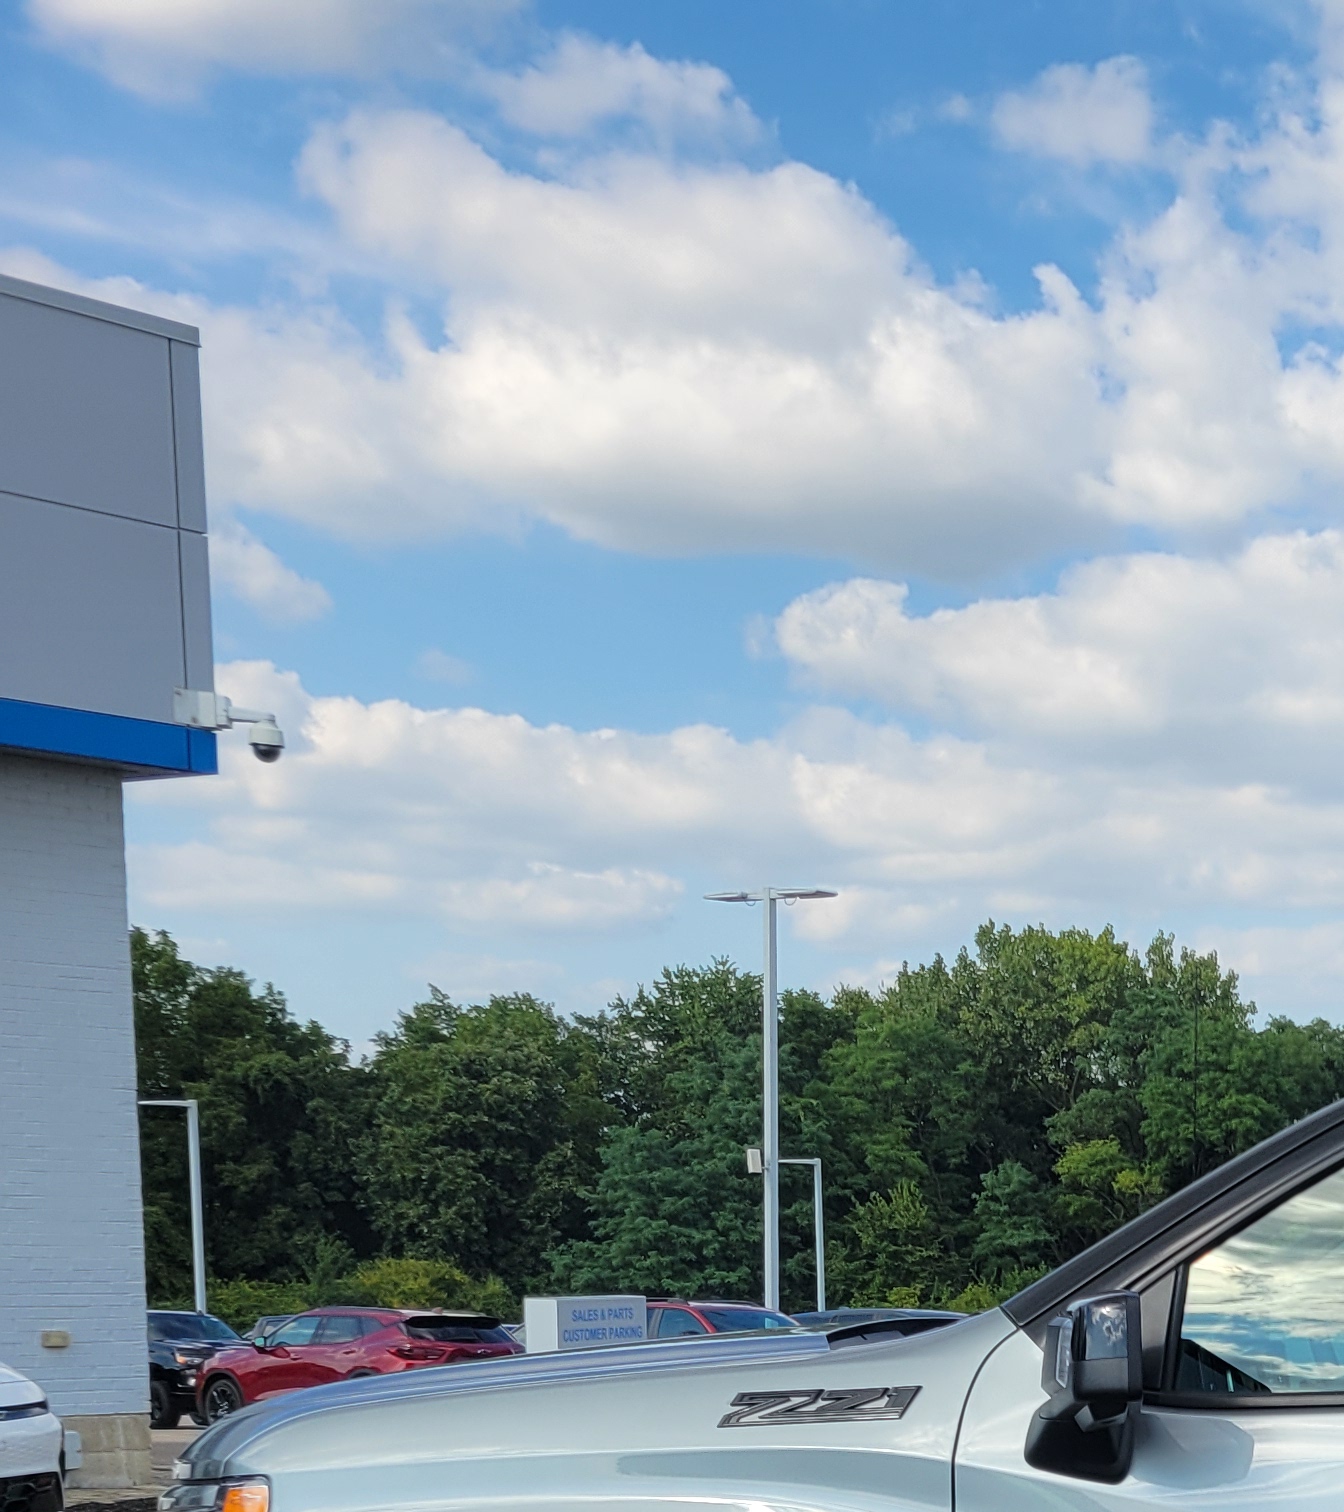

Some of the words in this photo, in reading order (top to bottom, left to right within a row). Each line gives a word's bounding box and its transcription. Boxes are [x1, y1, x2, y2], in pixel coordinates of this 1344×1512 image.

[572, 1309, 598, 1321] SALES
[608, 1307, 633, 1319] PARTS
[563, 1328, 607, 1342] CUSTOMER
[609, 1326, 643, 1339] PARKING
[717, 1385, 923, 1428] Z71
